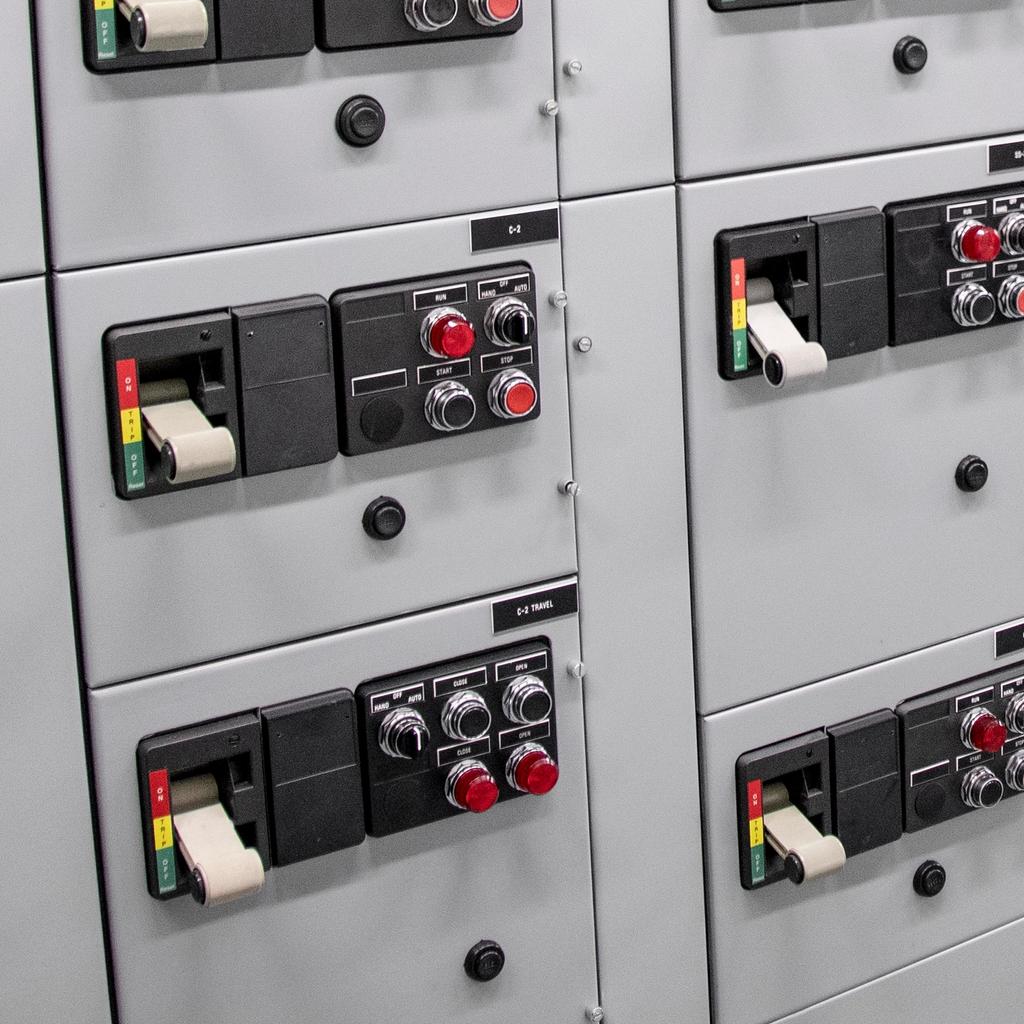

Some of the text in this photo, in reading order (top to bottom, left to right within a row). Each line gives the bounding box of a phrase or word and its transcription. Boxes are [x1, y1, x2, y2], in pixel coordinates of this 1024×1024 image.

[509, 225, 521, 235] C-2
[482, 284, 528, 299] HAND AUTO
[436, 293, 447, 302] RUN
[501, 356, 514, 365] STOP
[436, 366, 453, 376] START
[125, 377, 132, 392] ON
[517, 600, 553, 617] C-2 TRAVEL
[516, 663, 528, 672] OPEN
[453, 678, 468, 687] CLOSE
[374, 693, 422, 711] HAND AUTO
[519, 730, 531, 740] OPEN
[157, 787, 164, 801] ON
